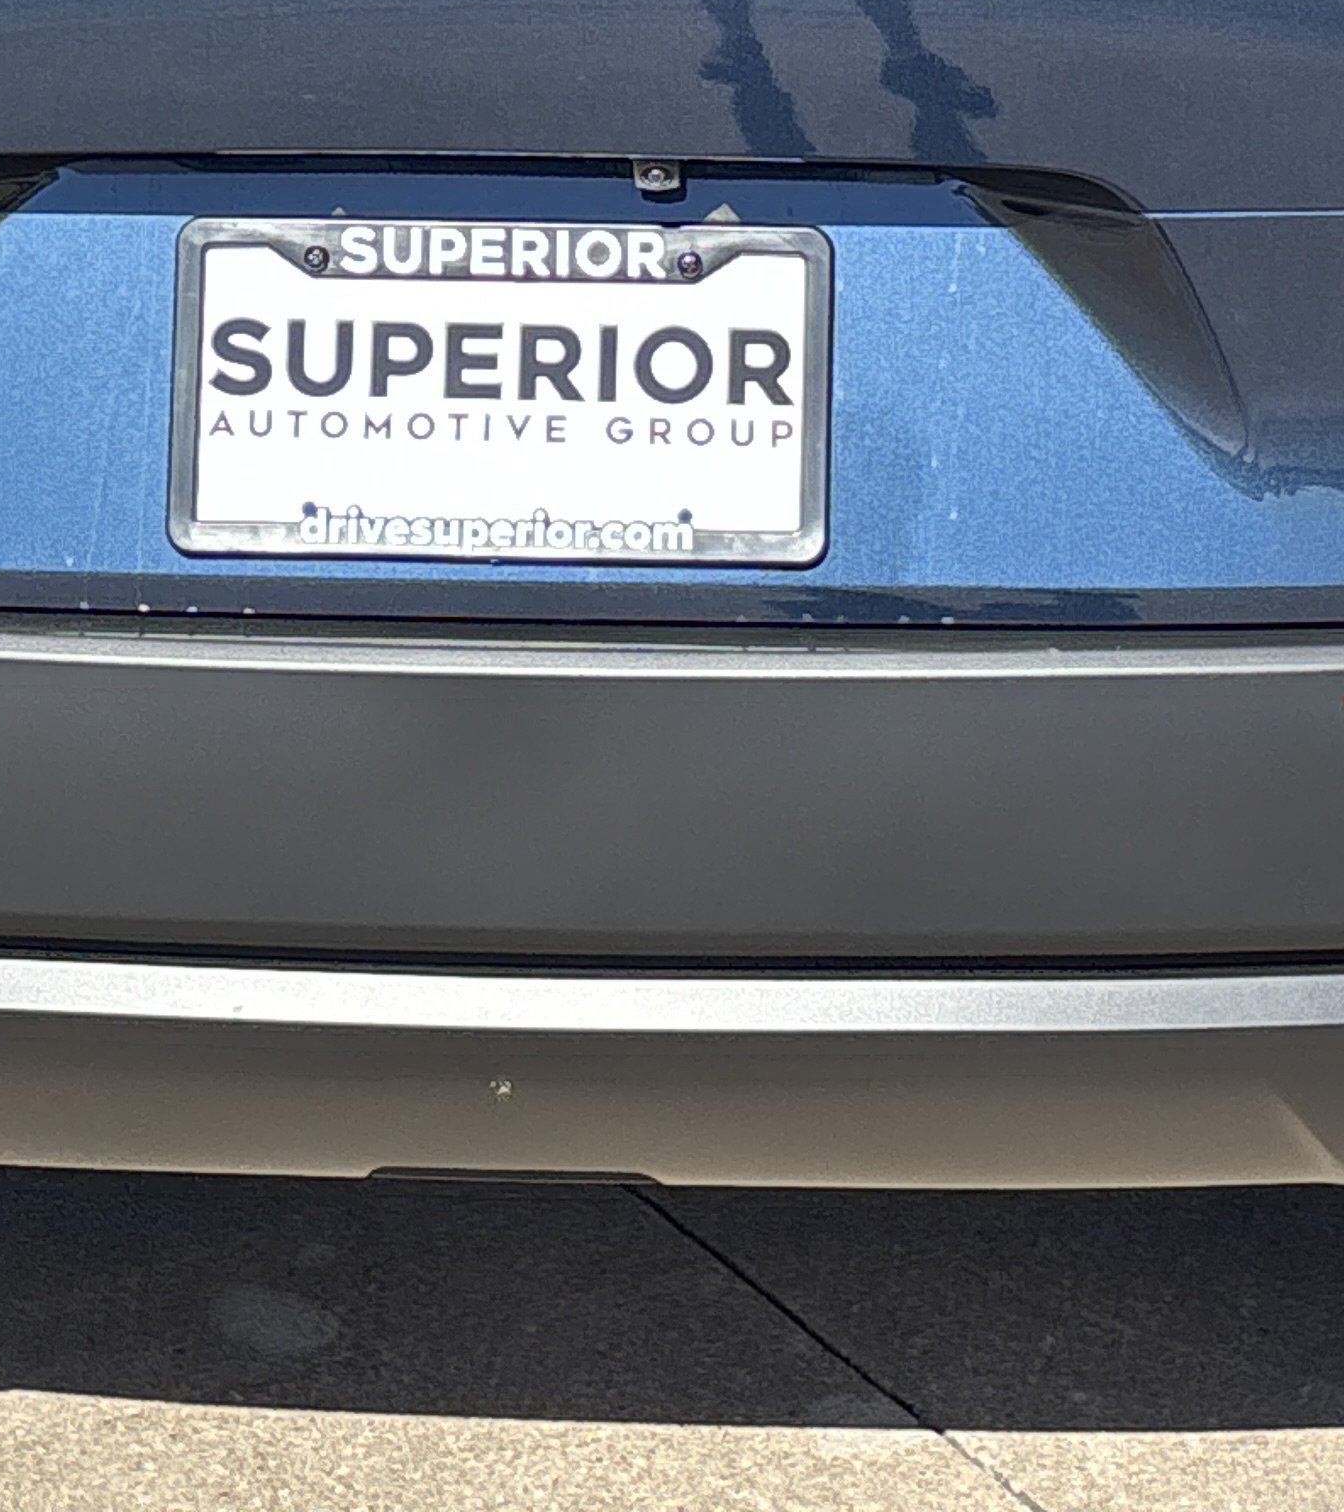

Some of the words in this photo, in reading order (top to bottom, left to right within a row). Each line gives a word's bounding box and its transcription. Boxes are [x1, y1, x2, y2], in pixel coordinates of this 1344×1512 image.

[340, 225, 666, 279] SUPERIOR
[208, 317, 795, 407] SUPERIOR
[209, 410, 567, 443] AUTOMOTIVE
[606, 418, 794, 448] GROUP
[300, 505, 695, 551] drivesuperior.com
